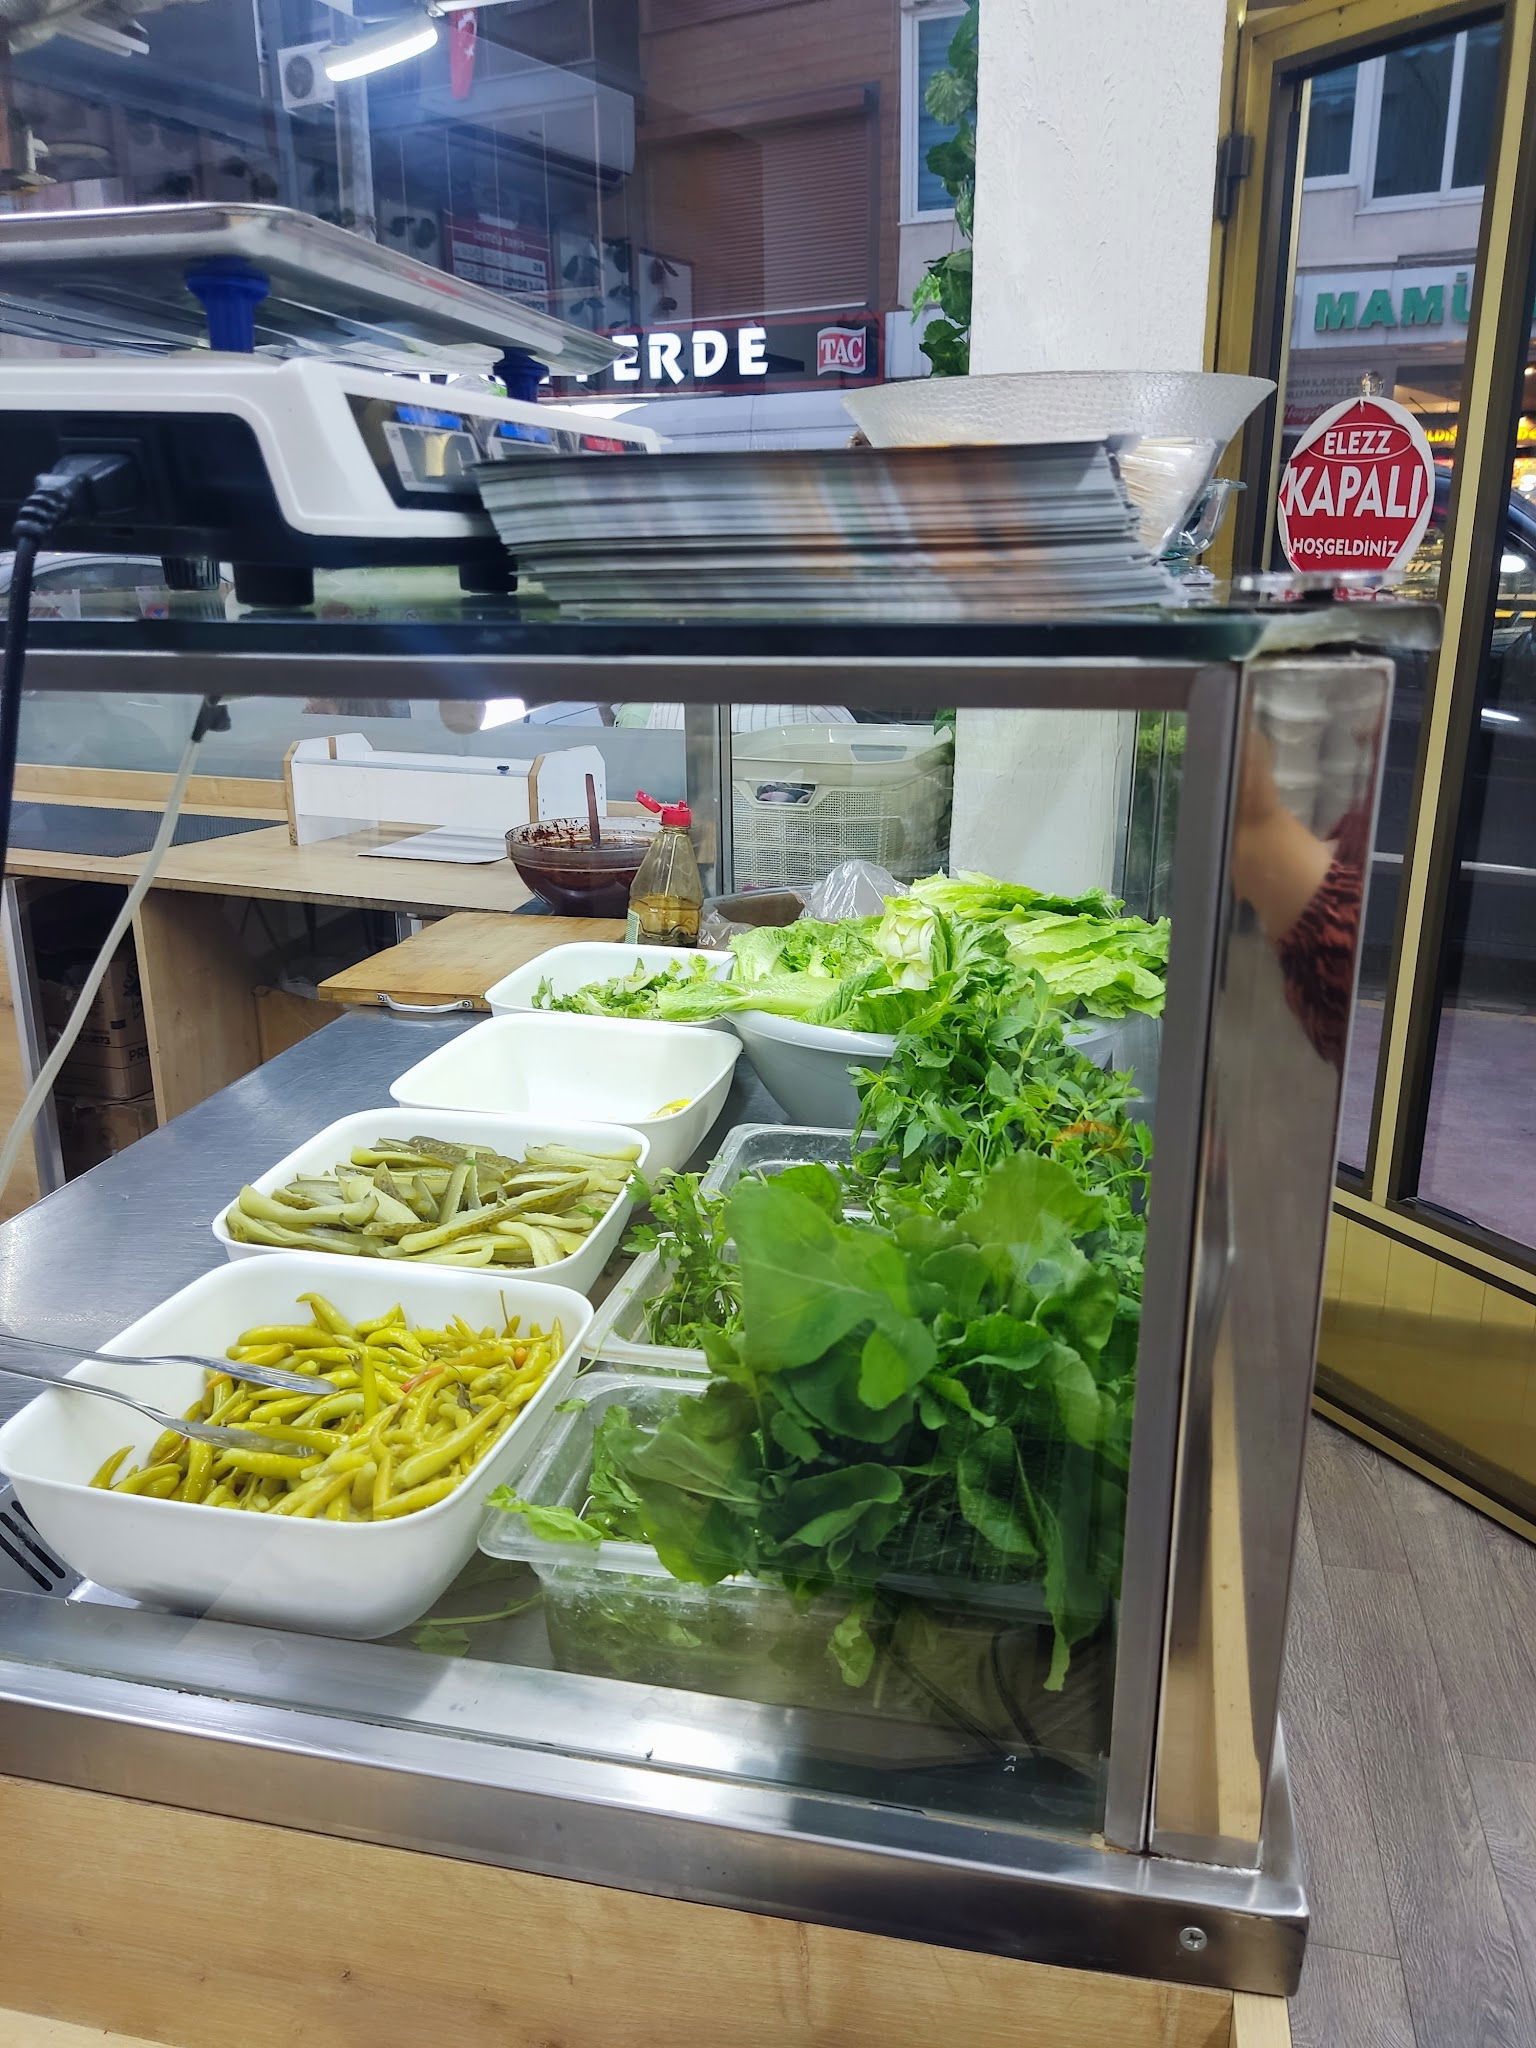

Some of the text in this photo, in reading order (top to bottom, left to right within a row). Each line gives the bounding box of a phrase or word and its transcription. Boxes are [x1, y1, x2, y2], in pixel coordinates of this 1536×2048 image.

[1323, 430, 1393, 456] ELEZZ
[1286, 465, 1424, 519] KAPALI
[1292, 535, 1399, 559] HOŞGELDİNİZ
